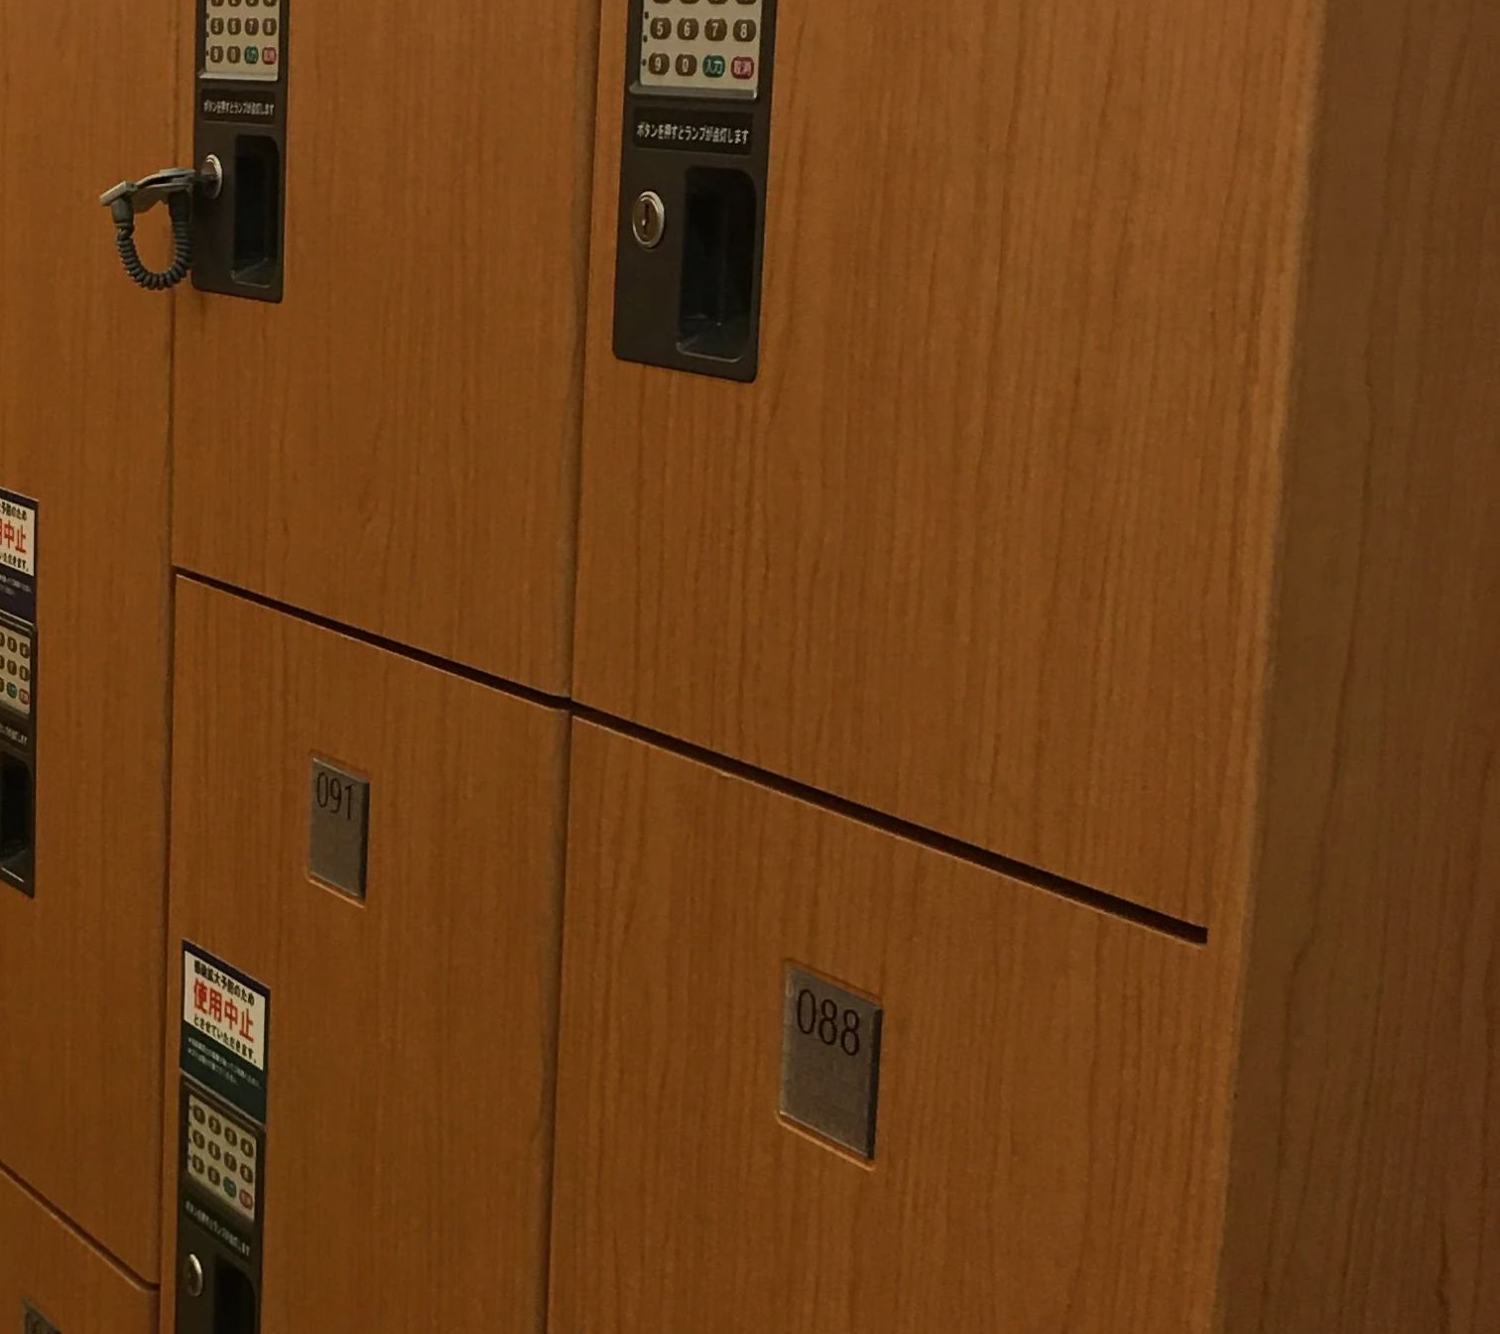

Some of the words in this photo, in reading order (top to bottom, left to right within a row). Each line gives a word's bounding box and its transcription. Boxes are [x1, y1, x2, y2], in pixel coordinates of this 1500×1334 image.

[705, 61, 724, 75] 入力
[316, 771, 354, 820] 091
[193, 978, 255, 1044] 使用中止
[797, 989, 860, 1056] 088
